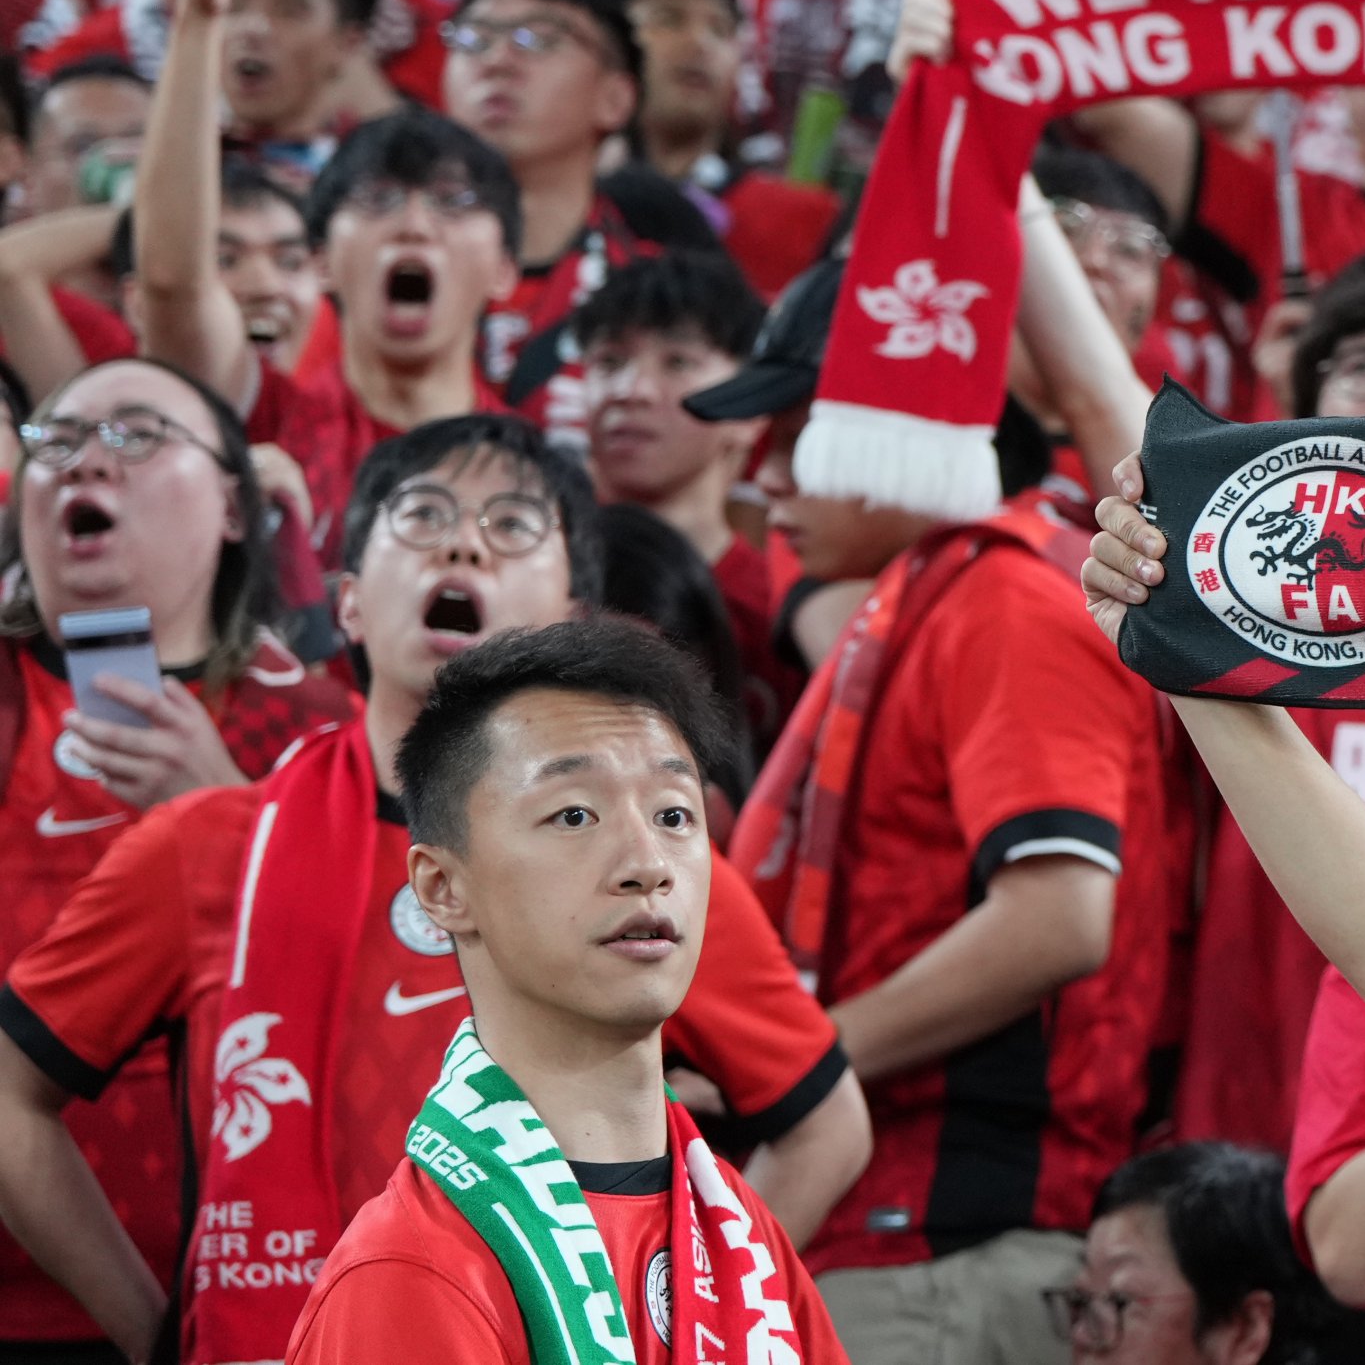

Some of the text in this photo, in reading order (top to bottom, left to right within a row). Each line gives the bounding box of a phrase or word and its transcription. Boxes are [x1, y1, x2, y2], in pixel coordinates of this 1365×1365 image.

[972, 12, 1193, 107] ONG
[1207, 486, 1243, 519] THE
[1238, 443, 1344, 493] FOOTBALL
[1193, 532, 1221, 594] 香港
[1280, 583, 1362, 622] FA
[1222, 605, 1287, 651] HONG
[1292, 638, 1364, 661] KONG,
[407, 1124, 490, 1191] 2025
[218, 1257, 327, 1289] KONG
[265, 1229, 317, 1258] OF
